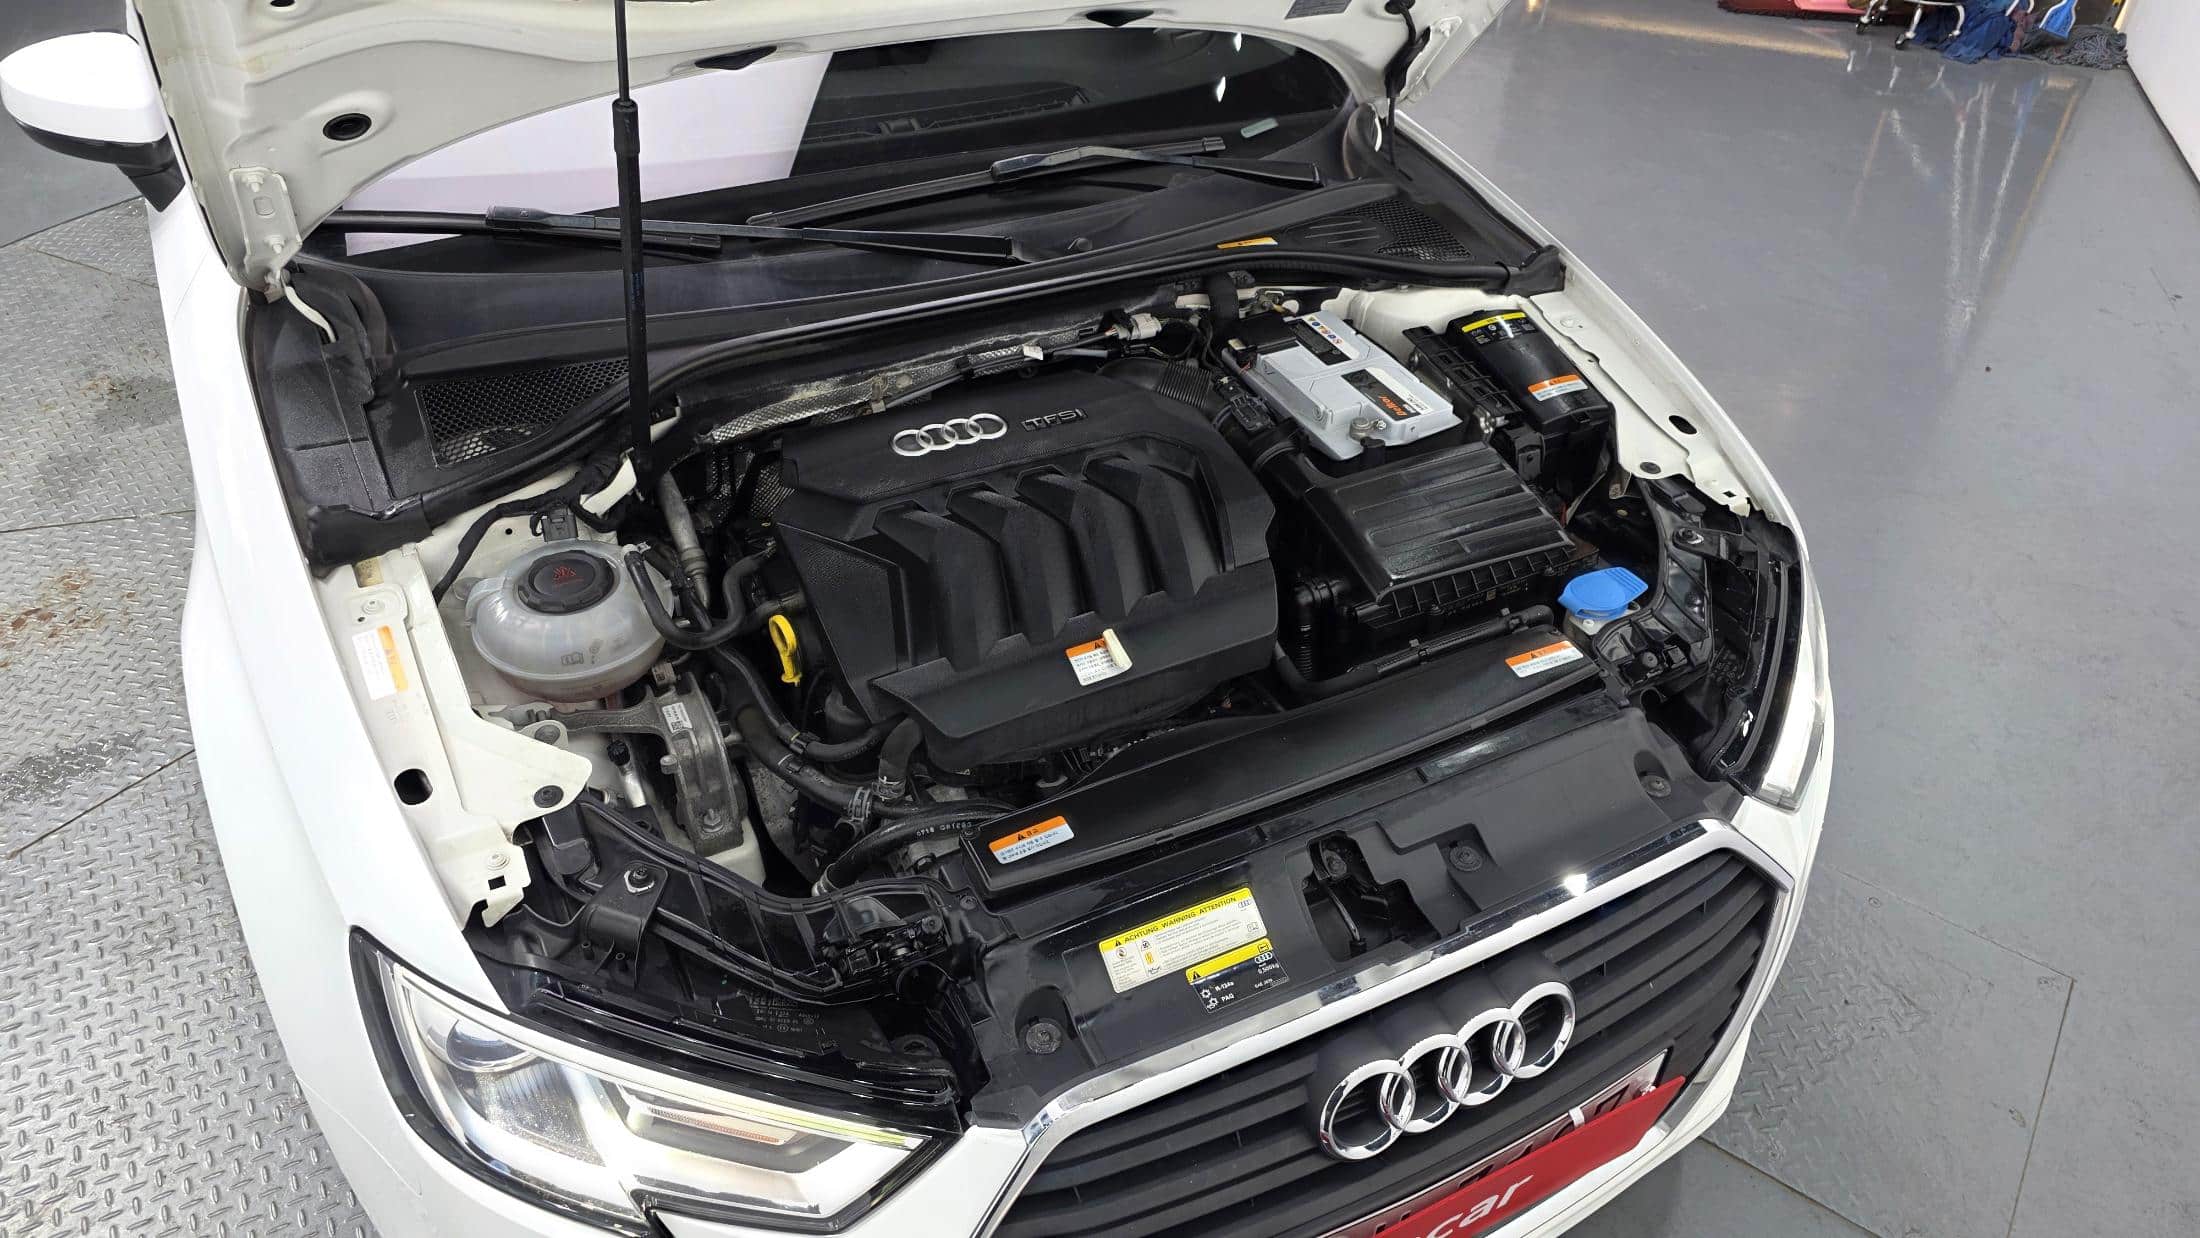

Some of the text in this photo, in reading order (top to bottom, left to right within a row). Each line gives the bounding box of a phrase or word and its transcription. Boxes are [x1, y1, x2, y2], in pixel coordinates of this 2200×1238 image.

[1022, 408, 1086, 429] TFSI
[1124, 897, 1237, 943] ACHTUNG WARNING ATTENTION
[1418, 1174, 1534, 1238] car
